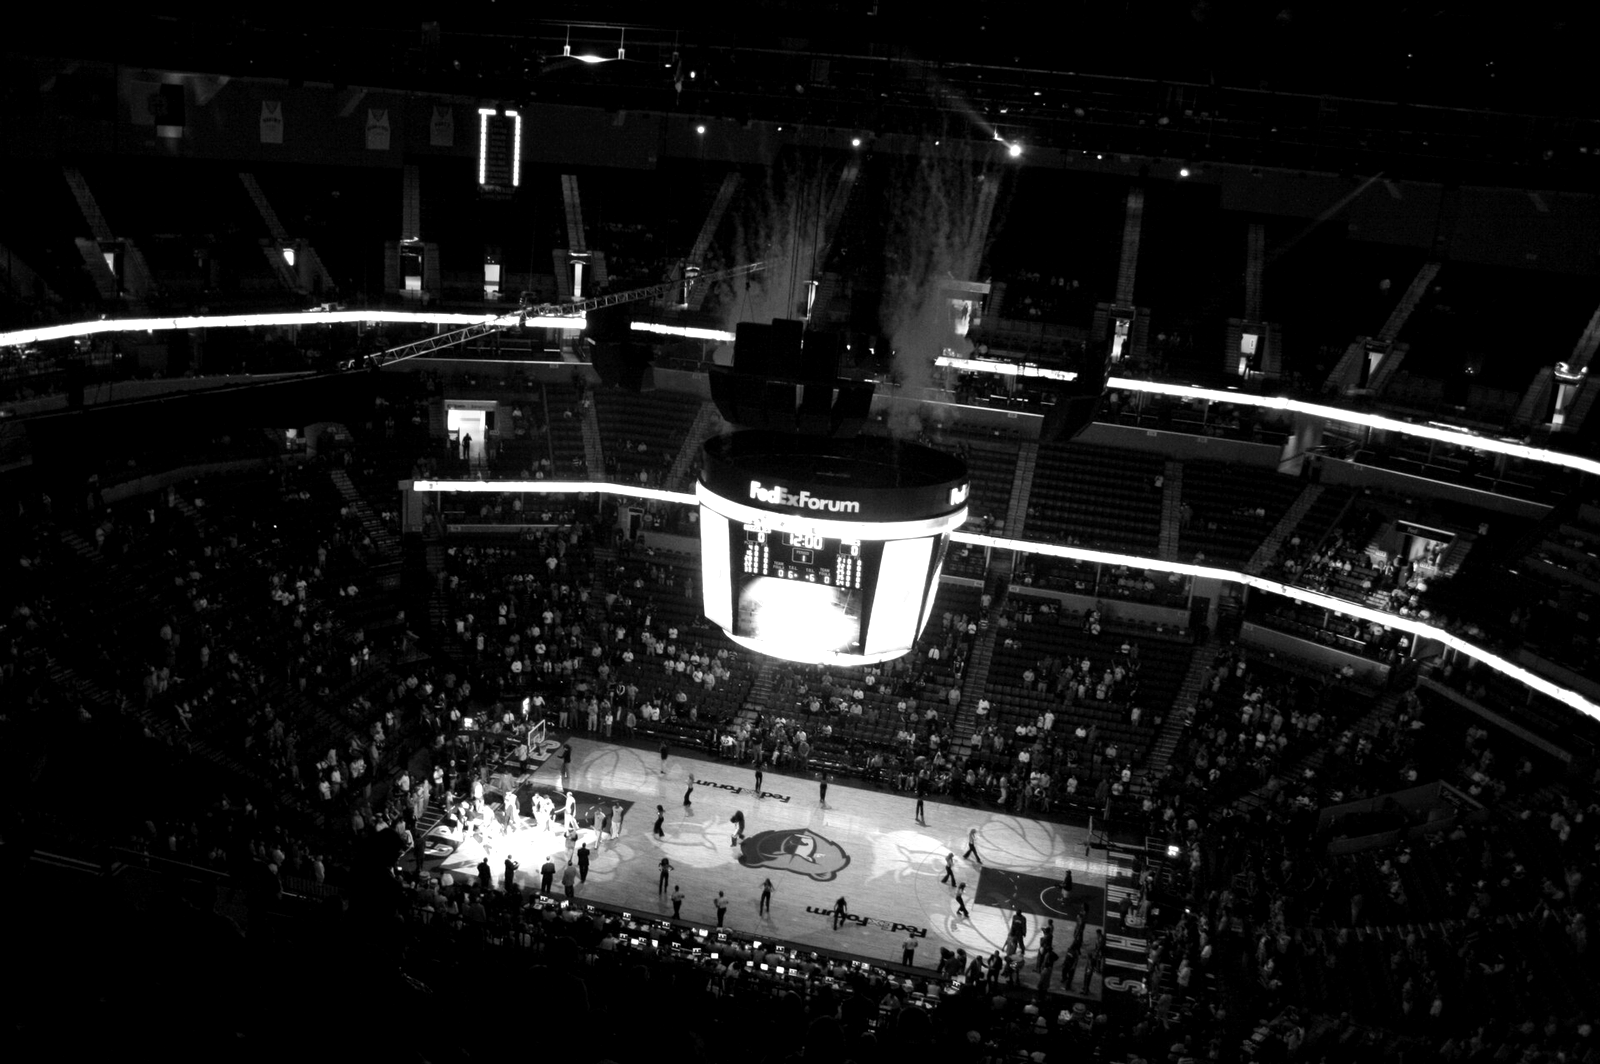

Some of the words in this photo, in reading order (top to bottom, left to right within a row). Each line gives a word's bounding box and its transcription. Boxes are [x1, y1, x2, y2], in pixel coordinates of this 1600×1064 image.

[749, 480, 860, 513] FedExForum
[789, 533, 823, 550] 12:00
[805, 905, 928, 938] FedExFoum
